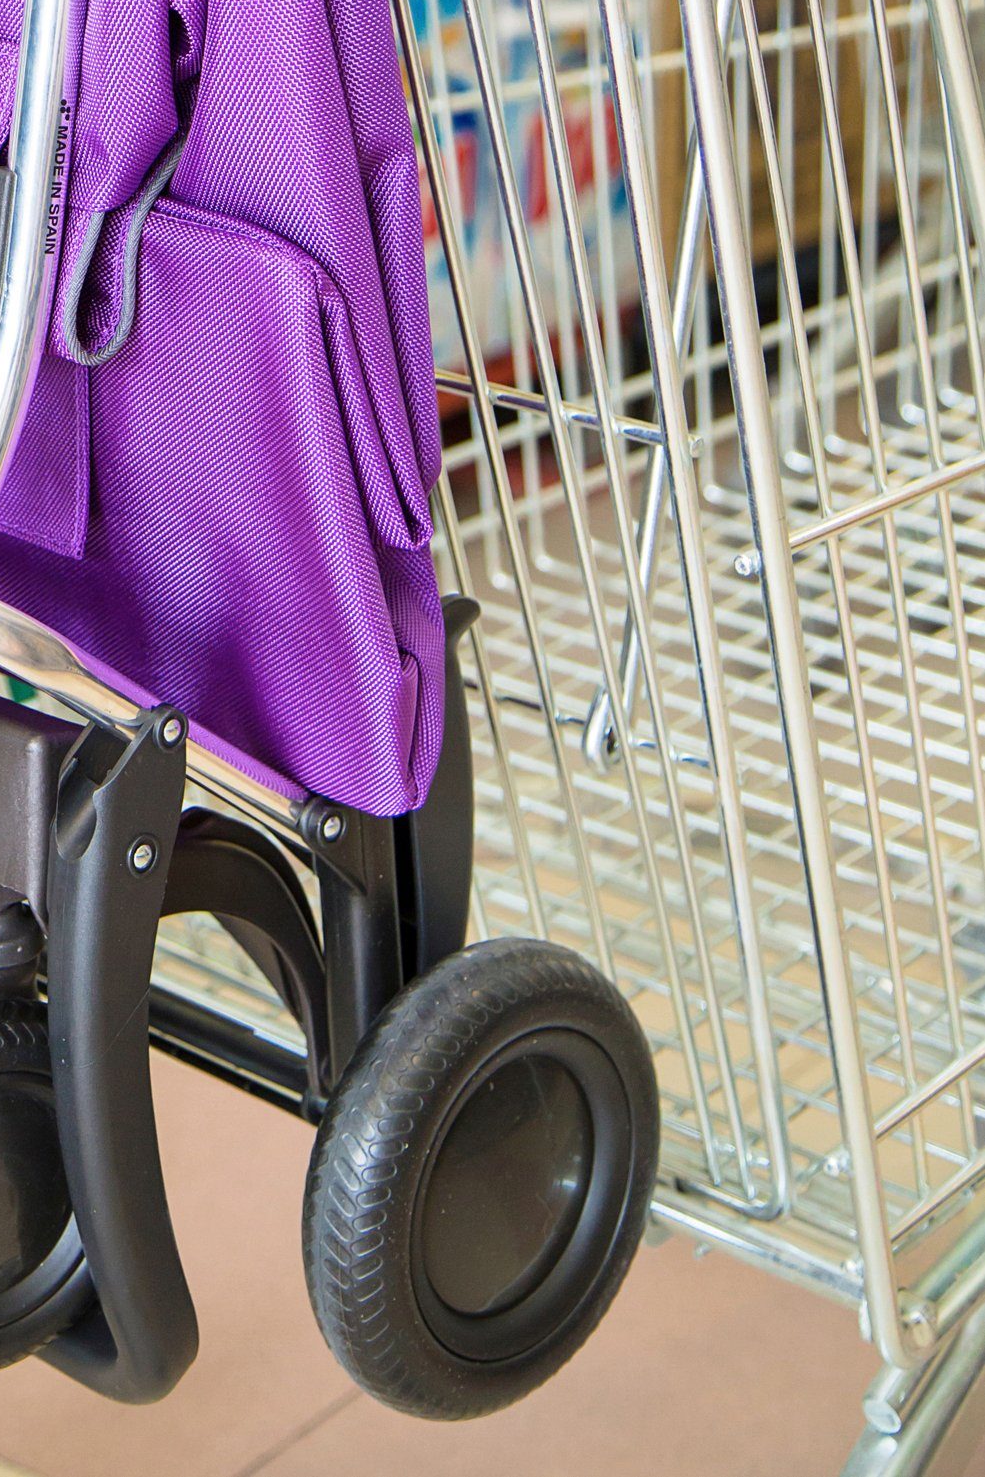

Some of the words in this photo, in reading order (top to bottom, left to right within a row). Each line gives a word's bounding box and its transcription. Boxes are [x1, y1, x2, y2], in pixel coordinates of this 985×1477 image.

[54, 126, 68, 177] MADE
[51, 182, 62, 199] IN
[44, 204, 60, 255] SPAIN
